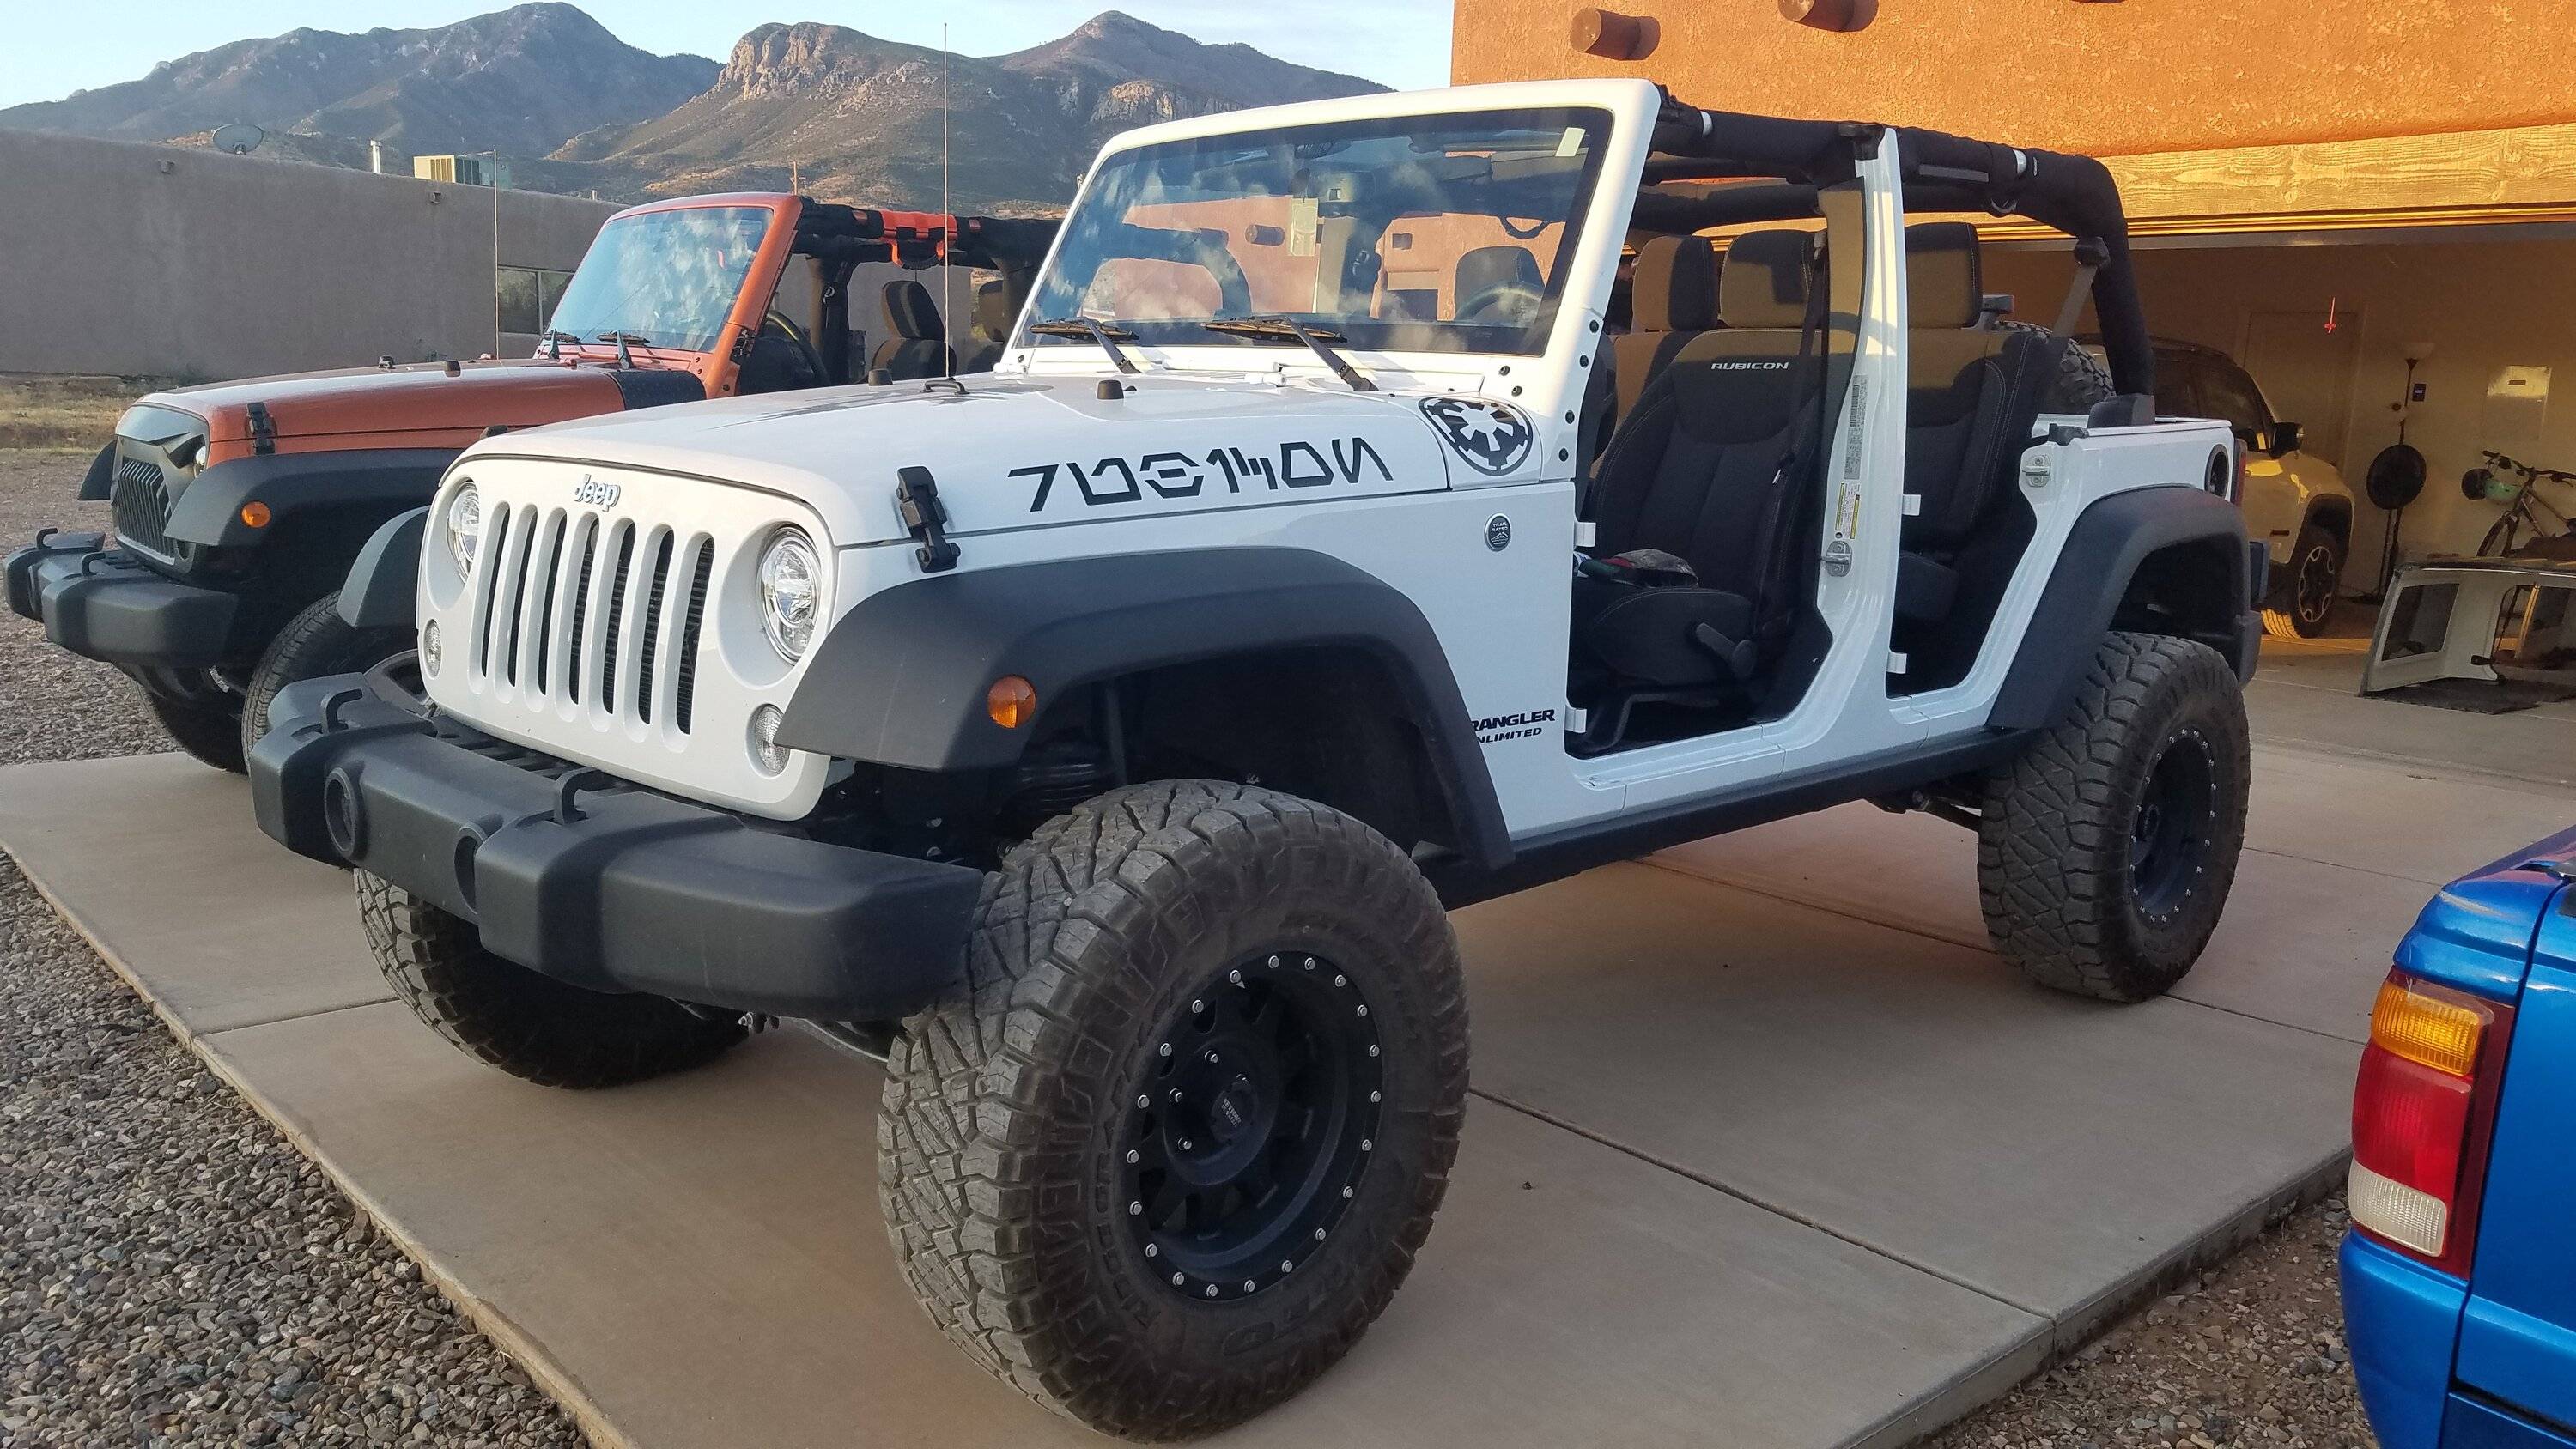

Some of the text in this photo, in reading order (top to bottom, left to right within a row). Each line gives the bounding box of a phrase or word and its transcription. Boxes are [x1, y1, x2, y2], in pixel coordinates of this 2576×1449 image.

[1710, 361, 1789, 370] RUBICON
[570, 474, 621, 512] Jeep
[1471, 709, 1555, 731] RANGLER
[1477, 727, 1542, 743] NLIMITED
